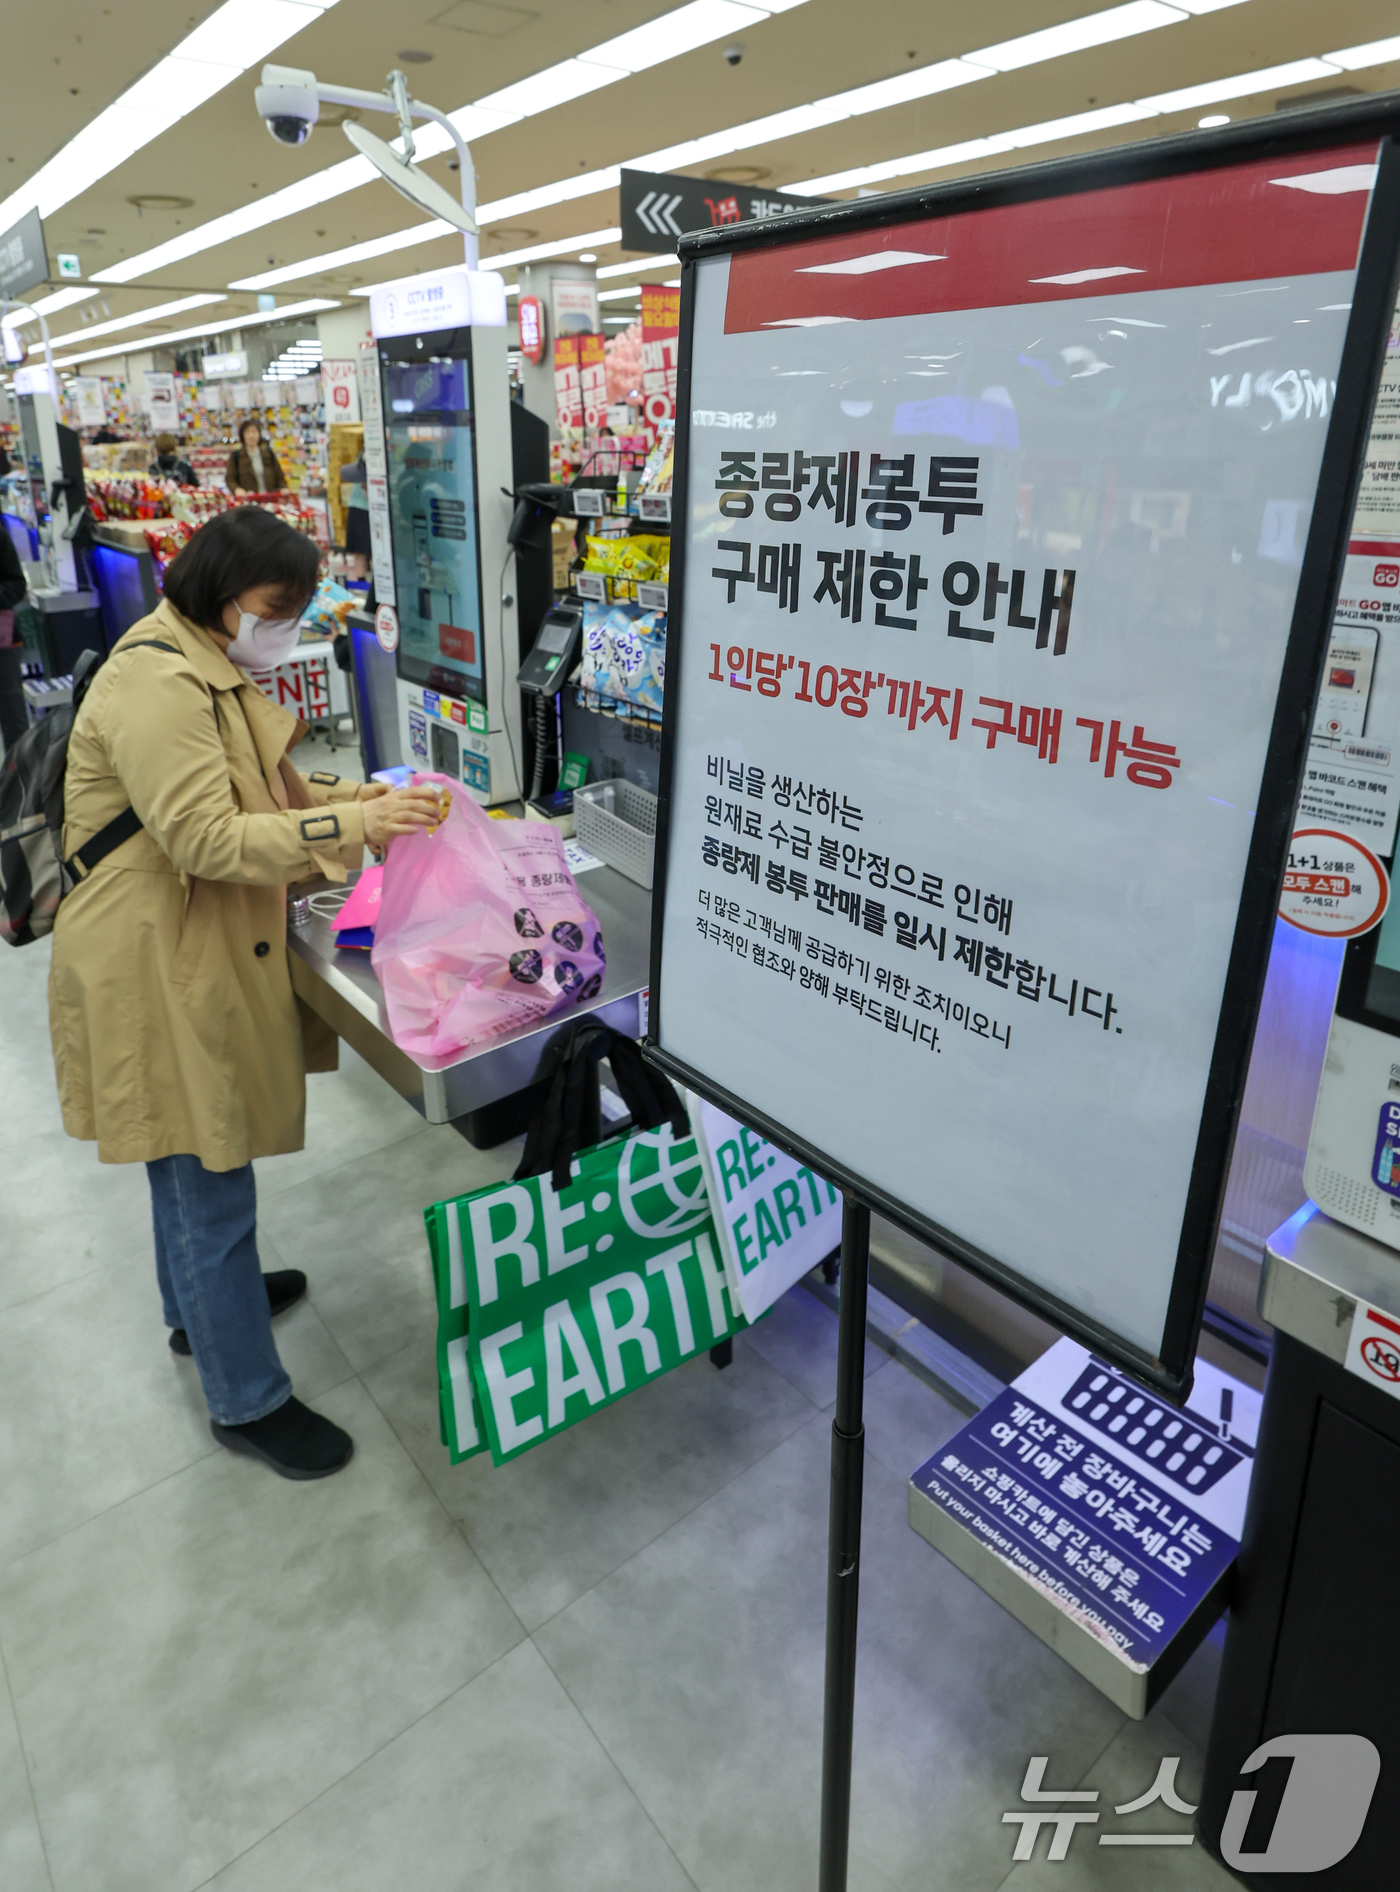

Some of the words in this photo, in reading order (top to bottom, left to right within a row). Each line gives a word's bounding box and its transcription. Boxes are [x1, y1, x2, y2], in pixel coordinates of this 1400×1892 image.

[715, 450, 983, 535] 종량제봉투
[712, 540, 801, 614] 구매
[813, 549, 928, 631] 제한
[942, 561, 1076, 656] 안내
[1359, 600, 1381, 611] GO
[1375, 573, 1397, 585] GO
[707, 754, 766, 800] 비닐을
[770, 774, 864, 831] 생산하는
[971, 696, 1062, 764] 구매
[1076, 716, 1181, 789] 가능
[1308, 769, 1318, 780] 앱
[1319, 772, 1346, 786] 바코드
[1347, 779, 1367, 791] 스캔
[1368, 782, 1387, 795] 혜택
[703, 794, 763, 840] 원재료
[767, 820, 812, 860] 수급
[817, 834, 945, 908] 불안정으로
[954, 883, 1013, 935] 인해
[1284, 875, 1311, 891] 모두
[1314, 877, 1345, 895] 스캔
[1350, 884, 1362, 895] 해
[1288, 853, 1321, 870] 1+1
[1323, 861, 1356, 874] 상품은
[1303, 895, 1340, 909] 주세요!
[695, 916, 748, 959] 적극적인
[751, 943, 796, 981] 협조와
[799, 966, 829, 998] 양해
[832, 982, 942, 1054] 부탁드립니다.
[698, 889, 711, 907] 더
[714, 895, 741, 923] 많은
[742, 908, 802, 953] 고객님께
[805, 936, 870, 984] 공급하기
[874, 967, 911, 1001] 위한
[913, 984, 1011, 1050] 조치이오니
[700, 834, 760, 884] 종량제
[764, 860, 809, 902] 봉투
[813, 878, 887, 937] 판매를
[893, 910, 946, 961] 일시
[953, 934, 1124, 1034] 제한합니다.
[469, 1160, 614, 1307] RE:
[990, 1421, 1063, 1481] 여기에
[1010, 1401, 1055, 1440] 계산
[1057, 1437, 1085, 1463] 전
[1081, 1453, 1212, 1556] 장바구니는
[926, 1480, 949, 1502] Put
[946, 1496, 975, 1520] your
[972, 1516, 1014, 1553] basket
[1010, 1547, 1040, 1574] here
[1038, 1569, 1082, 1607] before
[981, 1466, 1058, 1526] 쇼핑카트에
[1056, 1518, 1091, 1550] 담긴
[1087, 1542, 1141, 1590] 상품은
[983, 1482, 1028, 1528] 마시고
[1027, 1521, 1058, 1553] 바로
[1062, 1545, 1114, 1592] 계산해
[1109, 1584, 1166, 1634] 주세요
